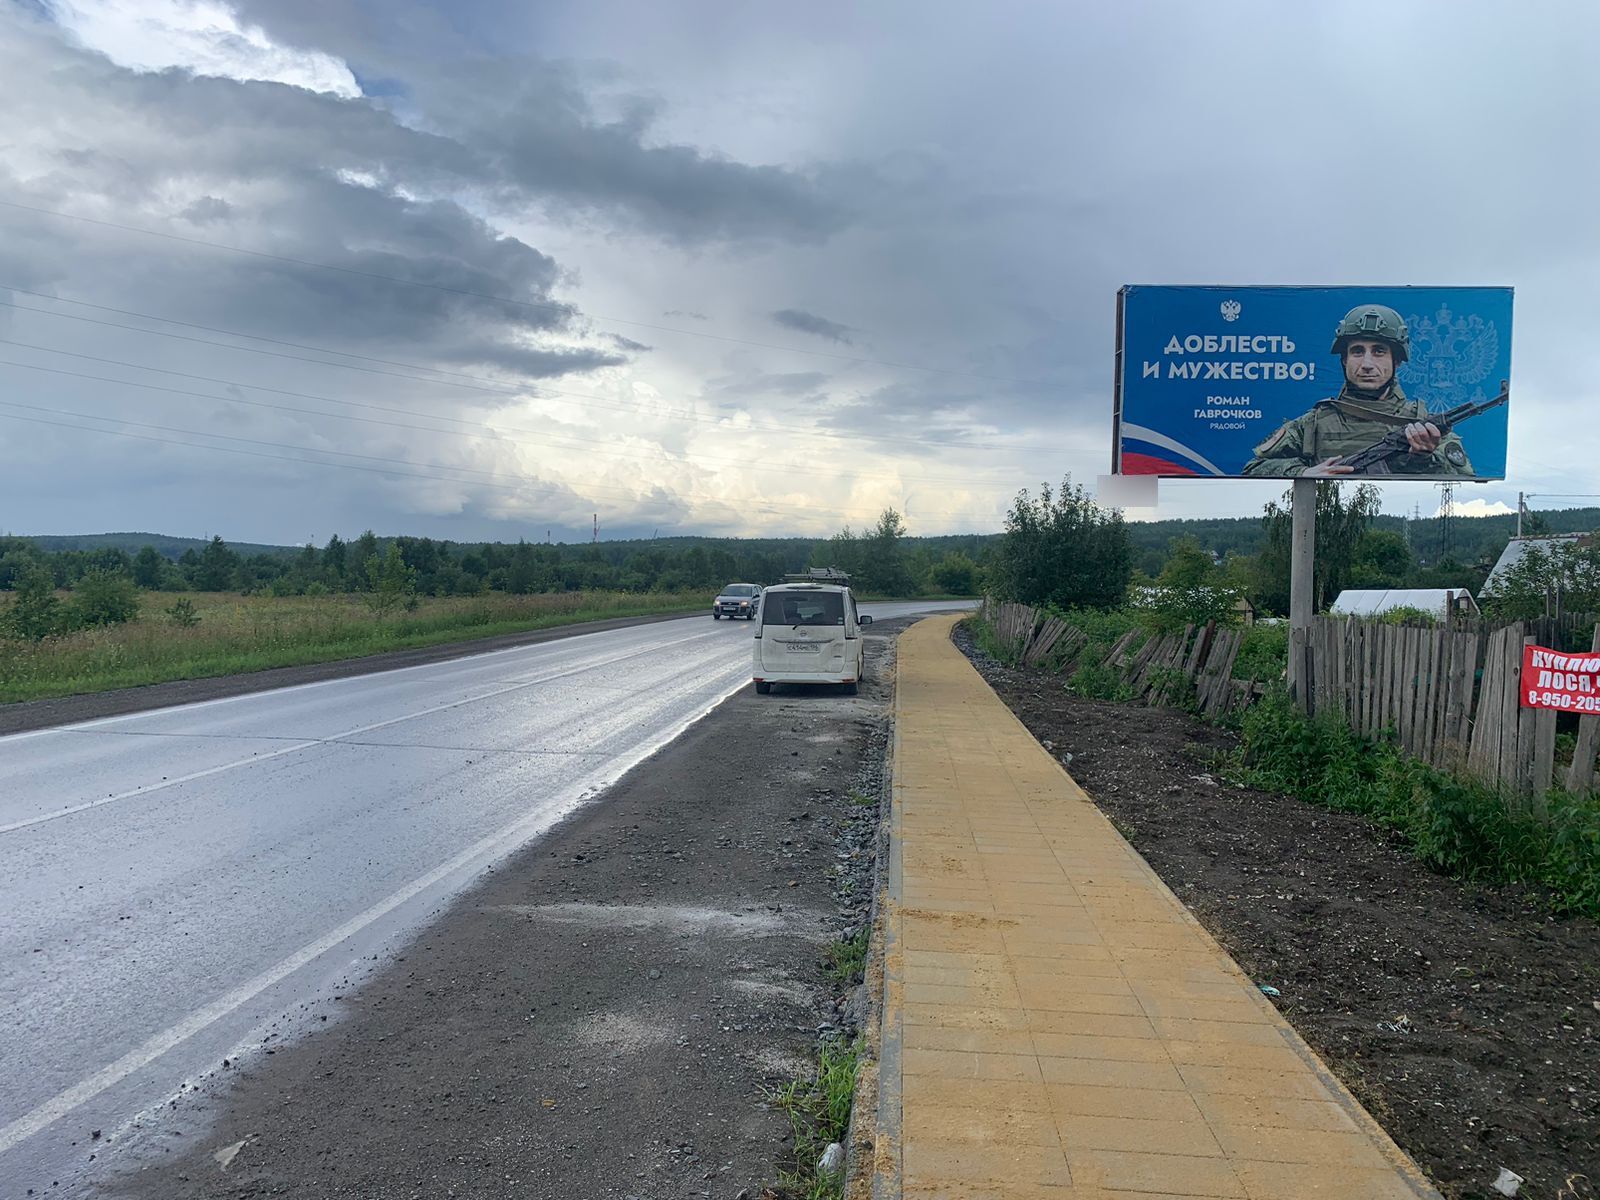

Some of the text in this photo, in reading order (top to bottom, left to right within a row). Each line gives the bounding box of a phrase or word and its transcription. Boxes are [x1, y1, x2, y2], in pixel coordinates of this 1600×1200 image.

[1164, 335, 1296, 355] ДОБЛЕСТЬ
[1143, 361, 1316, 381] И МУЖЕСТВО!
[1207, 396, 1250, 405] РОМАН
[1194, 409, 1262, 419] ГАВРОЧКОВ
[1210, 422, 1246, 430] РЯДОВОЙ
[1537, 671, 1595, 694] ЛОСЯ,
